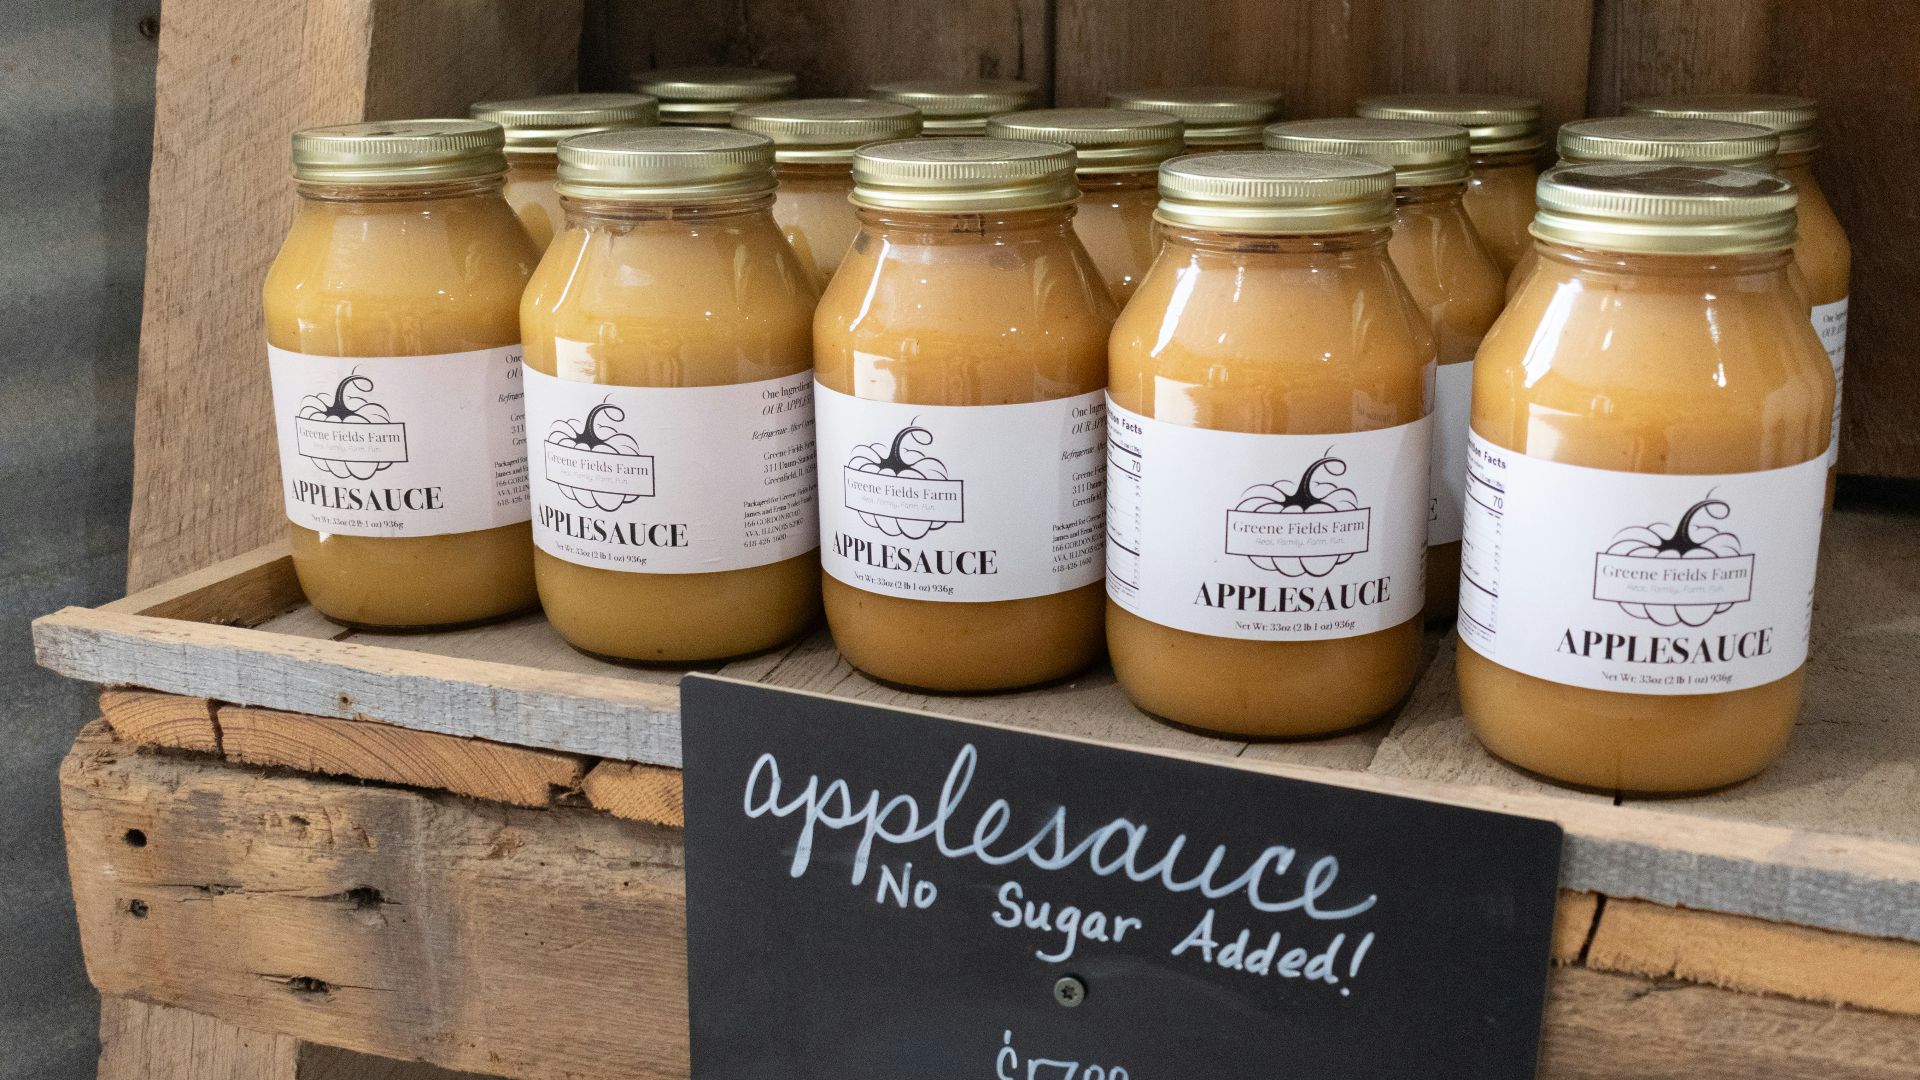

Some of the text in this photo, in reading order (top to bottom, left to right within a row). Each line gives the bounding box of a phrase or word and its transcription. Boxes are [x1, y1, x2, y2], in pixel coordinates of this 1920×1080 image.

[762, 390, 780, 400] One
[763, 402, 784, 415] OUR
[1072, 407, 1088, 418] One
[1072, 421, 1091, 435] OUR
[1122, 418, 1142, 435] Facts
[299, 427, 400, 442] Greene Fields Farm
[752, 427, 788, 441] Refrigerate
[763, 451, 787, 461] Greene
[1484, 451, 1506, 469] Facts
[547, 451, 649, 476] Greene Fields Farm
[763, 463, 777, 473] 311
[1132, 460, 1141, 473] 70
[292, 479, 444, 511] APPLESAUCE
[848, 478, 957, 501] Greene Fields Farm
[1072, 483, 1085, 494] 311
[744, 497, 770, 508] Packaged
[1493, 496, 1503, 509] 70
[744, 511, 761, 519] James
[756, 514, 785, 525] GORDON
[383, 520, 404, 529] 936g
[538, 502, 689, 548] APPLESAUCE
[1052, 520, 1078, 531] Packaged
[1233, 520, 1365, 535] Greene Fields Farm
[1052, 534, 1070, 543] James
[1070, 529, 1080, 538] and
[1064, 537, 1091, 550] GORDON
[832, 530, 998, 575] APPLESAUCE
[626, 555, 647, 565] 936g
[1602, 564, 1748, 582] Greene Fields Farm
[876, 577, 893, 587] 33oz
[894, 580, 902, 589] (2
[918, 584, 931, 592] oz)
[932, 584, 954, 595] 936g
[1193, 576, 1391, 612] APPLESAUCE
[1269, 623, 1292, 632] 33oz
[1293, 623, 1302, 632] (2
[1320, 622, 1333, 630] oz)
[1334, 620, 1355, 630] 936g
[1556, 627, 1774, 664] APPLESAUCE
[1638, 674, 1661, 684] 33oz
[1664, 675, 1674, 685] (2
[1694, 675, 1709, 684] oz)
[1710, 674, 1733, 684] 936g
[743, 743, 1377, 920] applesauce
[875, 862, 1376, 996] No Sugar Added!
